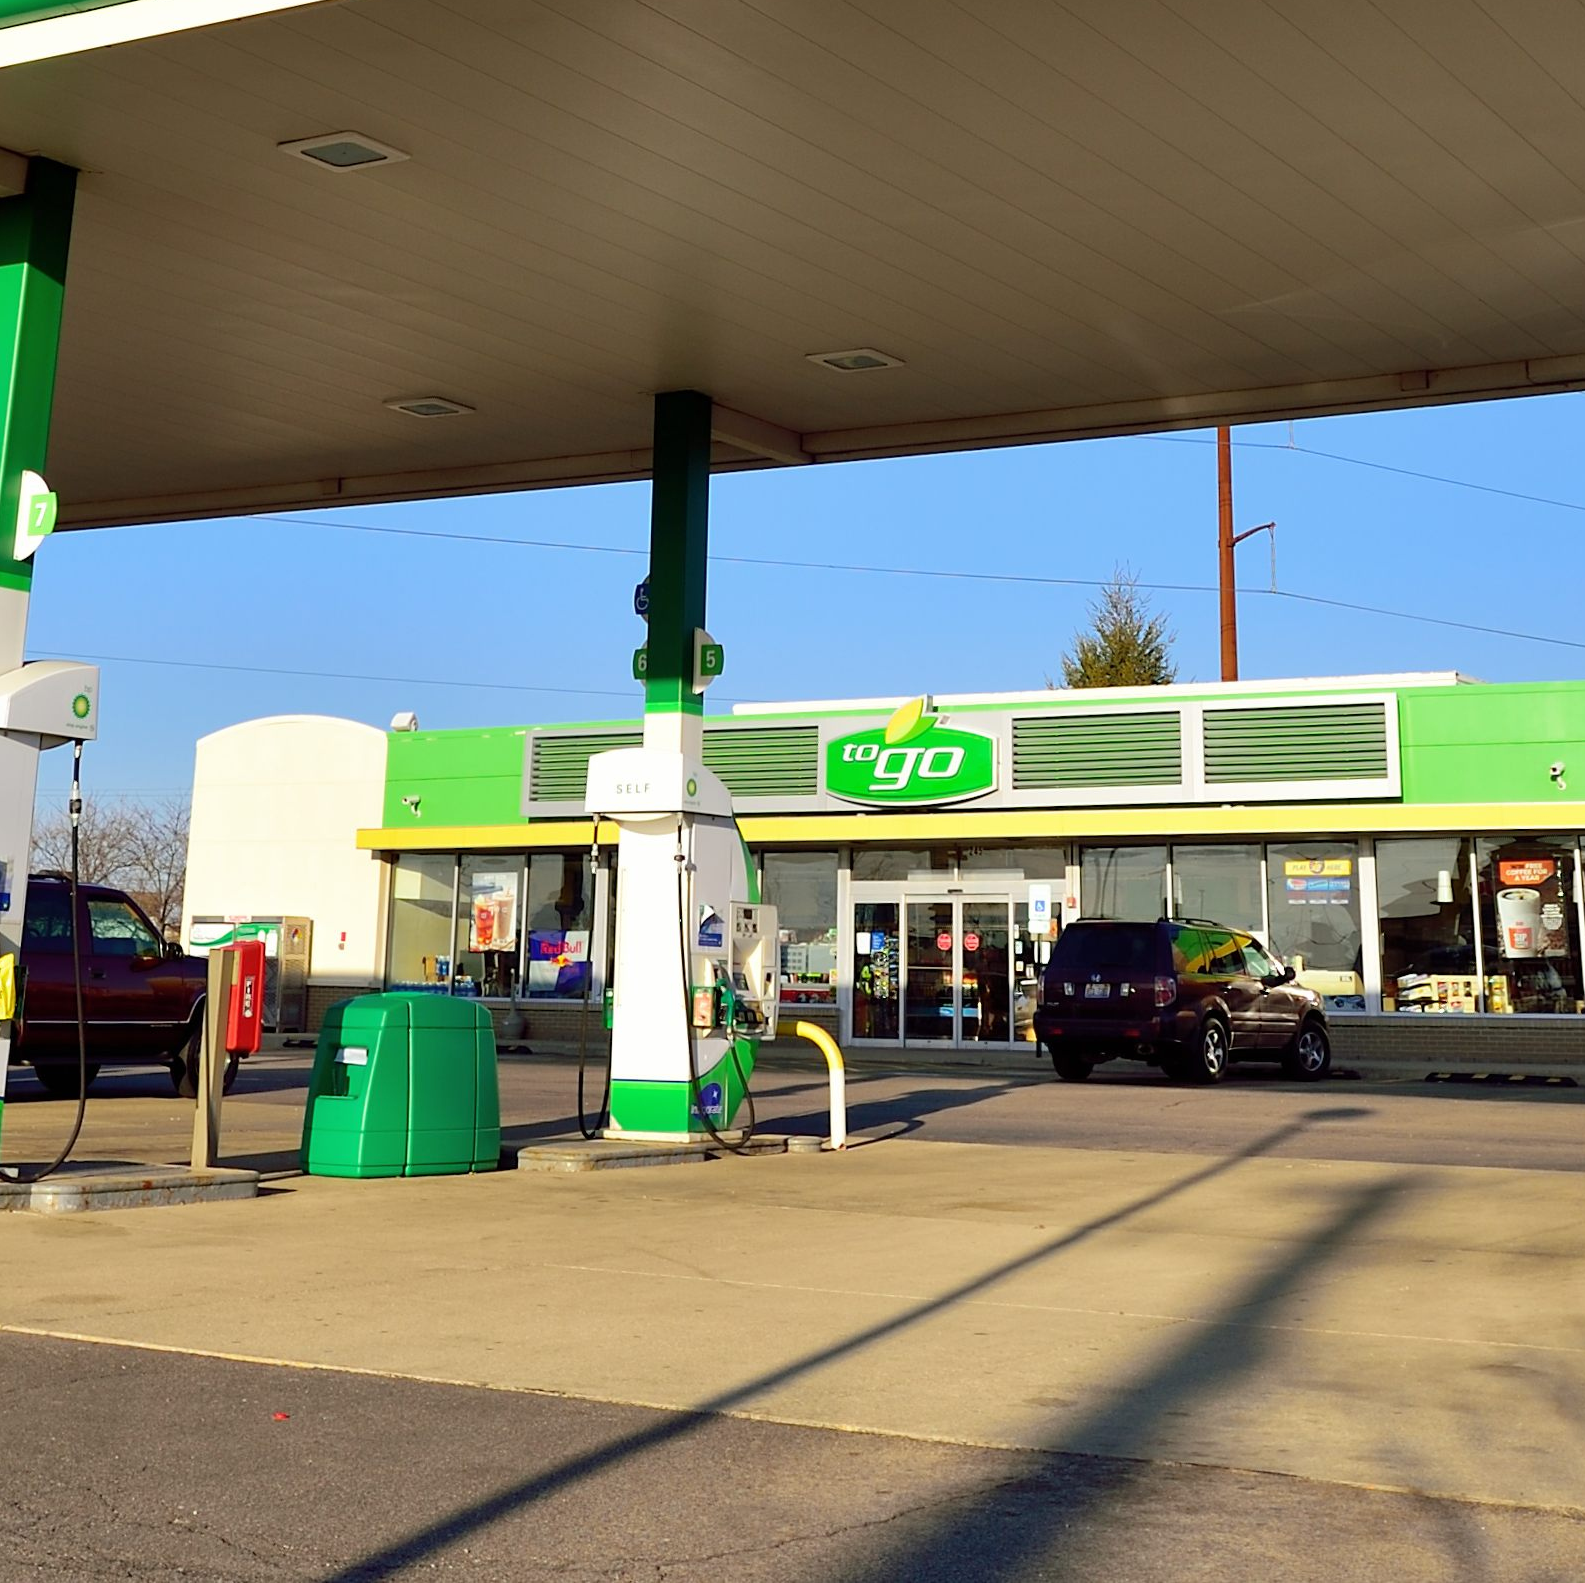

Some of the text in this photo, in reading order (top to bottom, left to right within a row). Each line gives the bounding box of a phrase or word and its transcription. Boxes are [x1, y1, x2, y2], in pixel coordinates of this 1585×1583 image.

[34, 502, 48, 527] 7
[637, 653, 647, 672] 6
[705, 649, 716, 668] 5
[842, 743, 966, 791] to go
[616, 783, 651, 794] SELF
[540, 941, 582, 954] Red Bull
